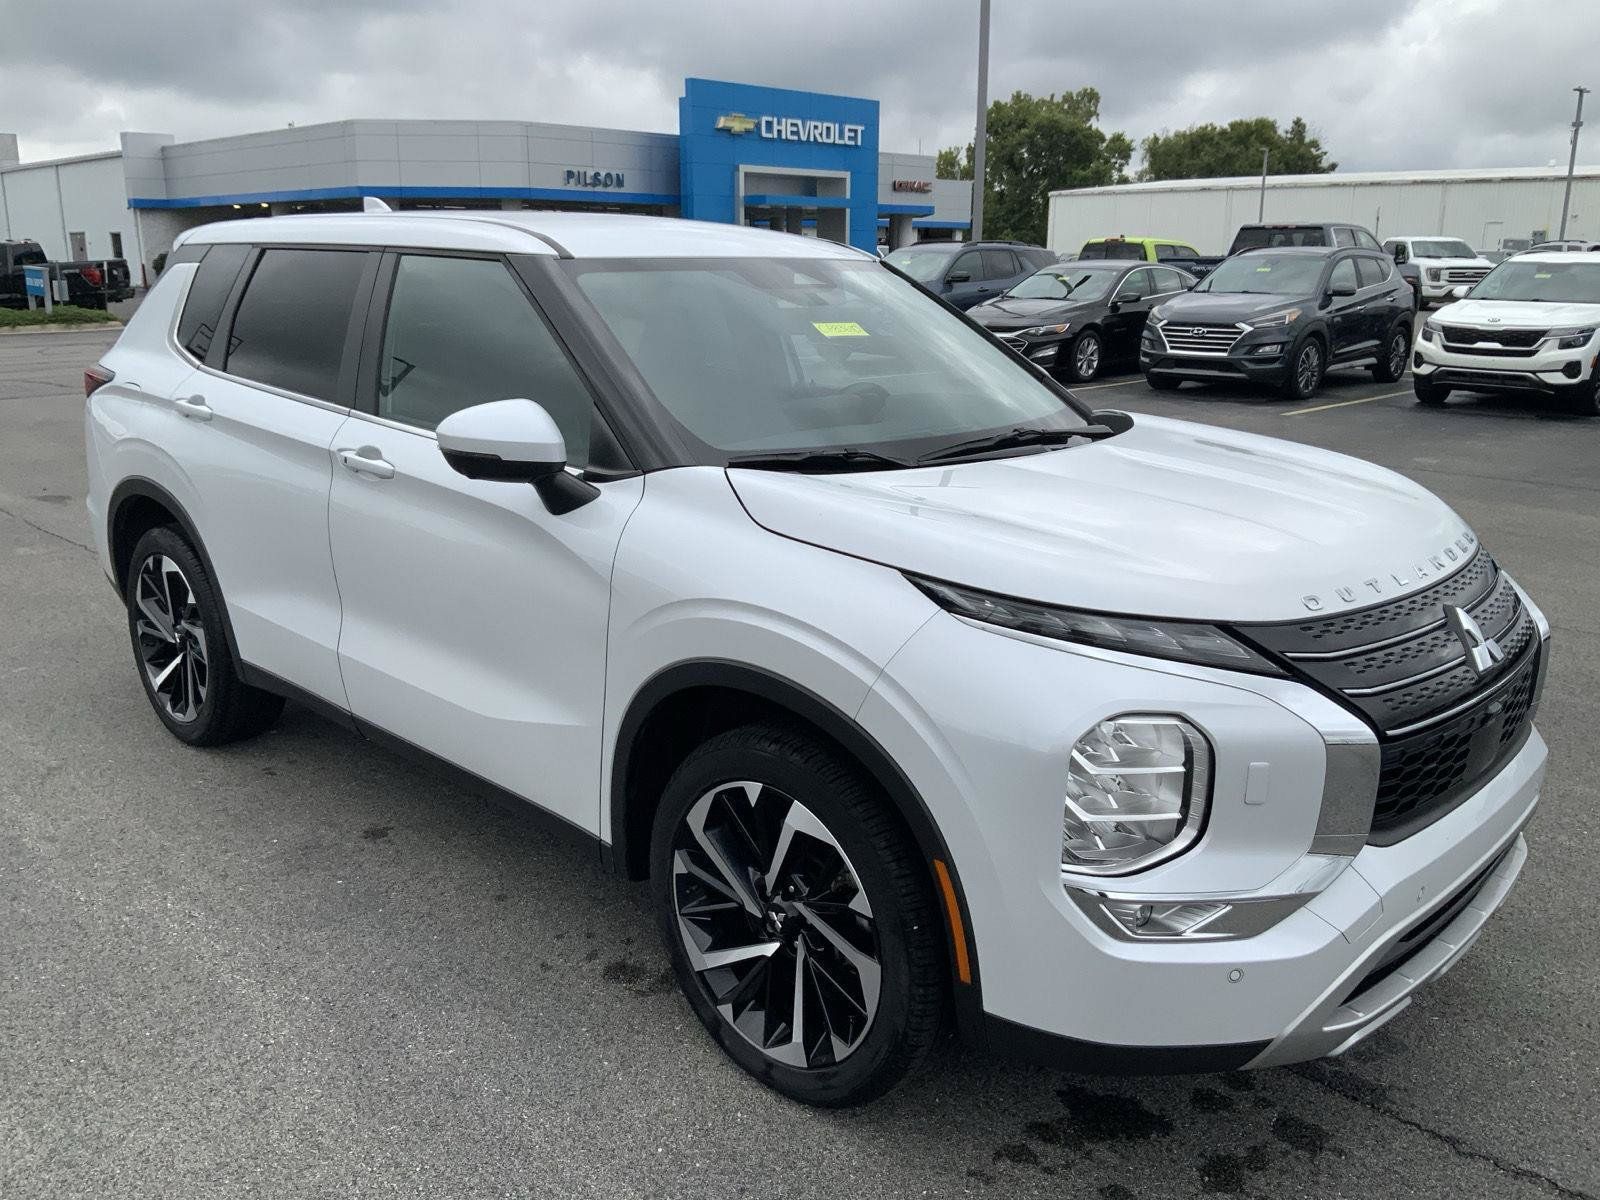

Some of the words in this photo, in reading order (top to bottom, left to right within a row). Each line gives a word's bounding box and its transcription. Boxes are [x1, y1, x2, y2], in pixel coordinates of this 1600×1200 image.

[761, 116, 865, 146] CHEVROLET
[565, 169, 625, 188] PILSON
[1301, 532, 1475, 611] OUTLANDER
